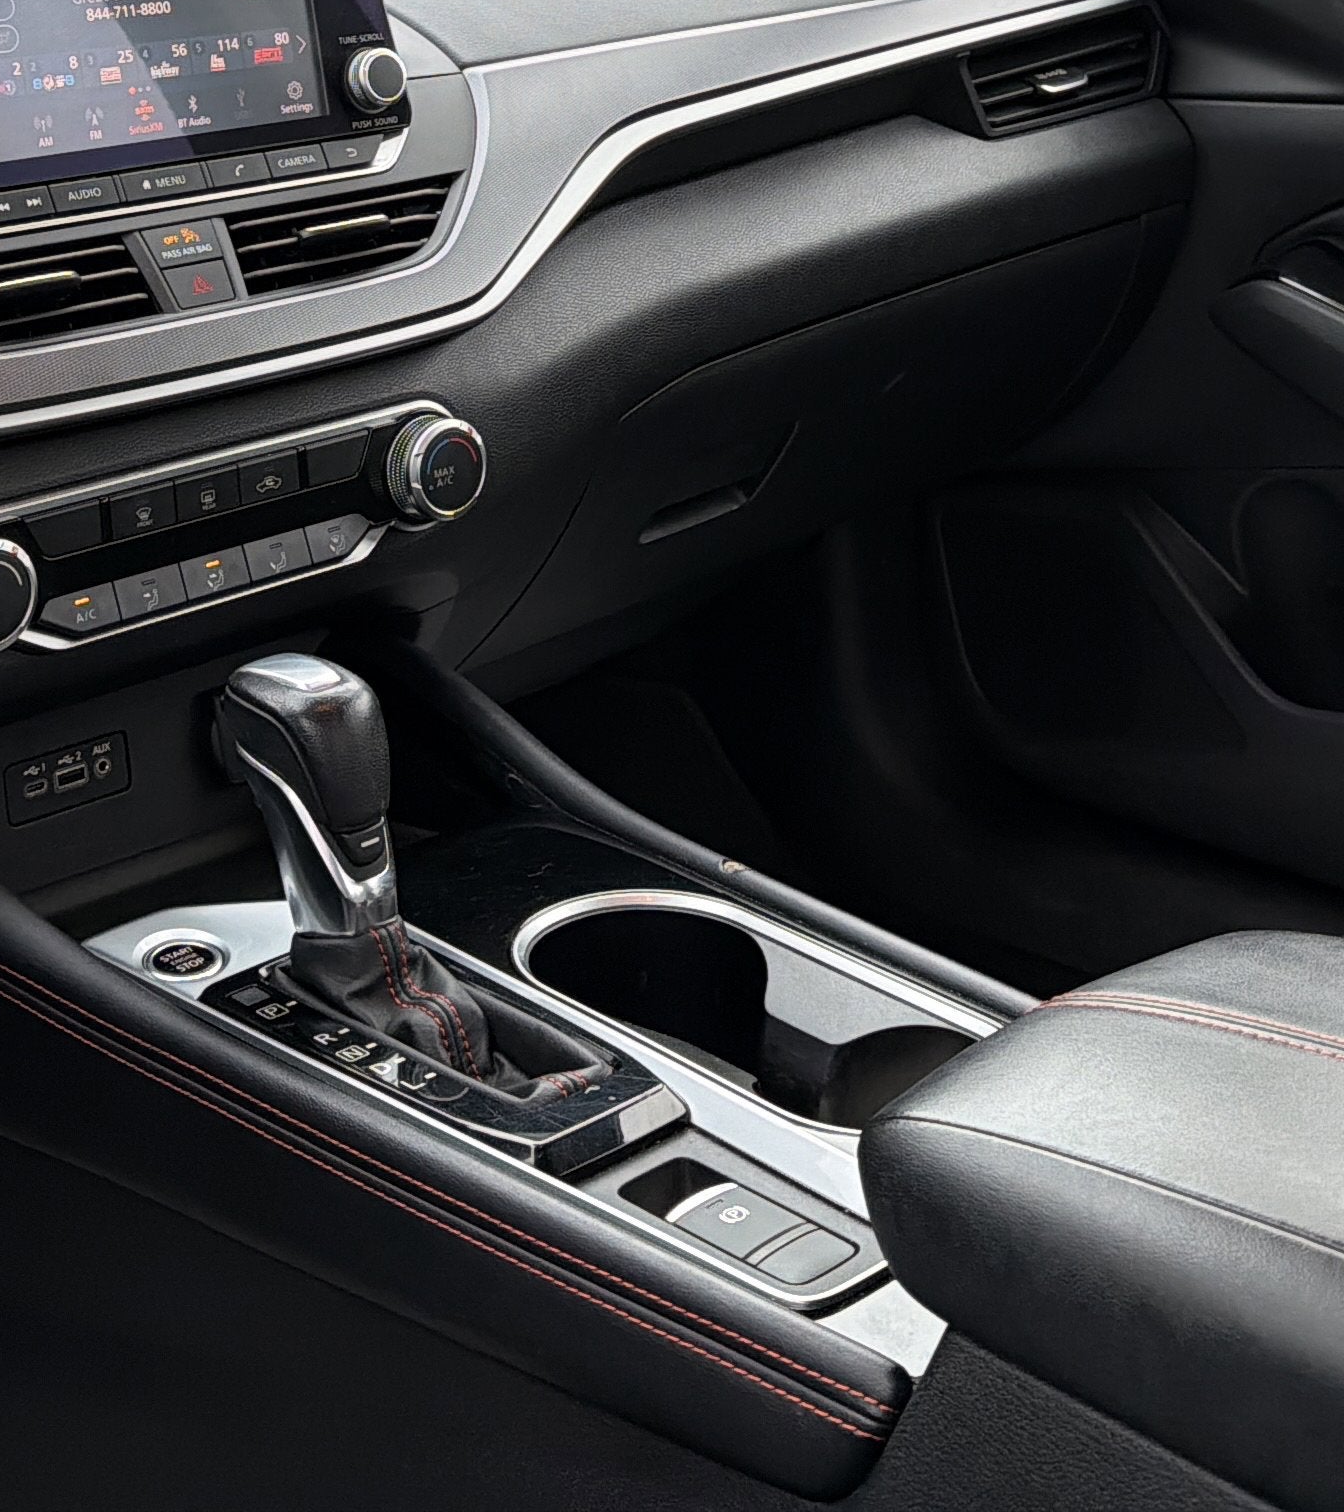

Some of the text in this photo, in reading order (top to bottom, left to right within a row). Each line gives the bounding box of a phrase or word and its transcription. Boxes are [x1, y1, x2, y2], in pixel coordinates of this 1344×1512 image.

[85, 0, 172, 22] 844-711-8800
[217, 38, 240, 52] 114
[274, 32, 290, 45] 80
[117, 49, 134, 64] 25
[142, 50, 149, 59] 4
[171, 44, 188, 58] 56
[68, 55, 80, 70] 8
[86, 55, 94, 66] 3
[12, 62, 23, 76] 2
[280, 102, 314, 115] Settings
[177, 115, 212, 129] BT Audio
[351, 115, 399, 130] PUSH SOUND
[89, 129, 103, 141] FM
[128, 123, 165, 136] SiriusXM
[38, 136, 54, 148] AM
[277, 153, 317, 169] CAMERA
[155, 174, 187, 189] MENU
[67, 186, 103, 202] AUDIO
[162, 234, 180, 246] OFF
[161, 242, 213, 260] PASS AIR BAG
[433, 466, 456, 479] MAX
[436, 475, 454, 488] A/C
[75, 608, 97, 624] A/C
[75, 750, 83, 761] 2
[91, 741, 112, 757] AUX
[159, 944, 195, 964] START
[175, 955, 206, 973] STOP
[313, 1032, 339, 1046] R
[343, 1047, 363, 1060] N
[368, 1061, 394, 1076] D
[399, 1079, 426, 1091] L
